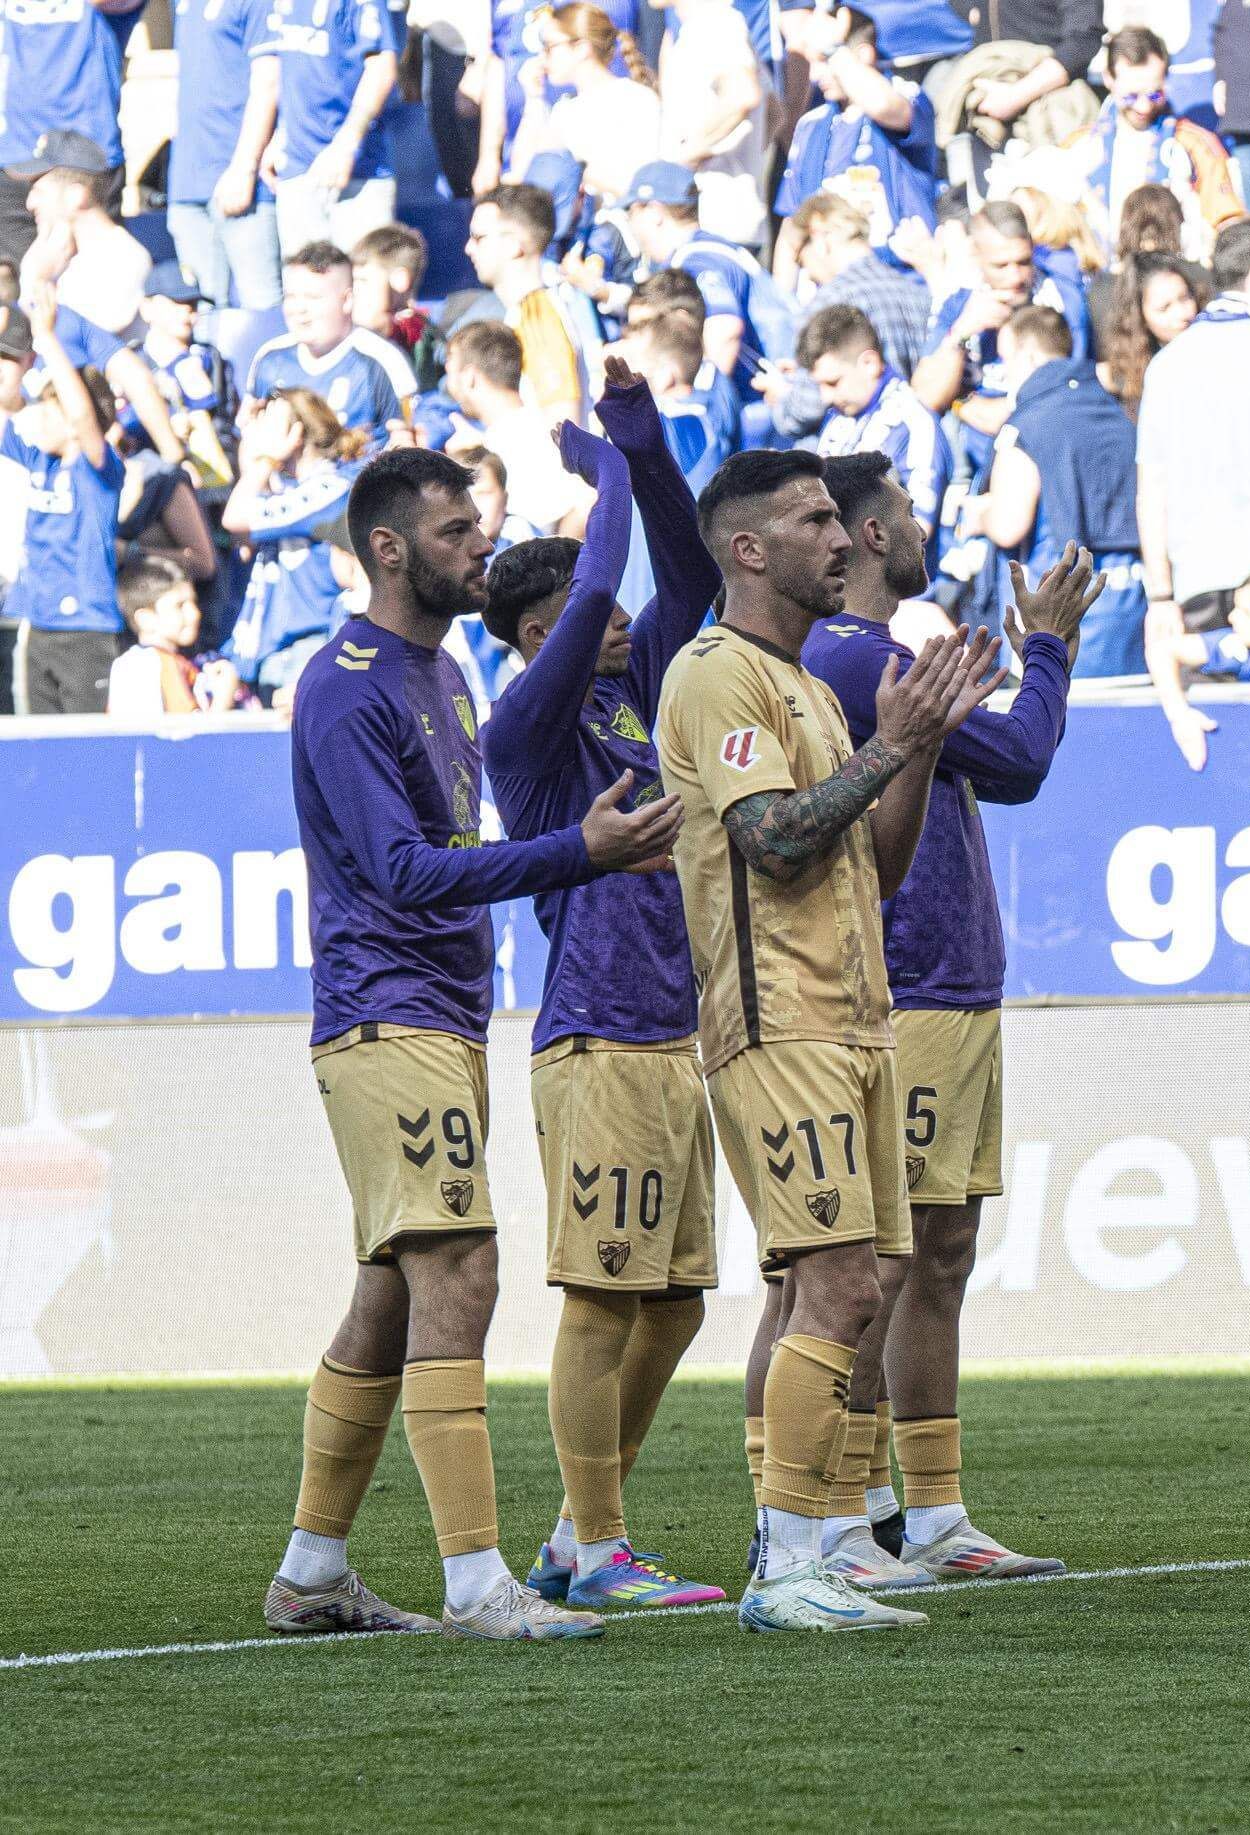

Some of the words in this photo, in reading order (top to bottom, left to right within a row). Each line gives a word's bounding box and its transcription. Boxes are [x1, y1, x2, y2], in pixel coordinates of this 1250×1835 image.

[442, 1107, 475, 1170] 9
[796, 1112, 857, 1181] 17
[906, 1085, 938, 1148] 5
[608, 1167, 662, 1231] 10
